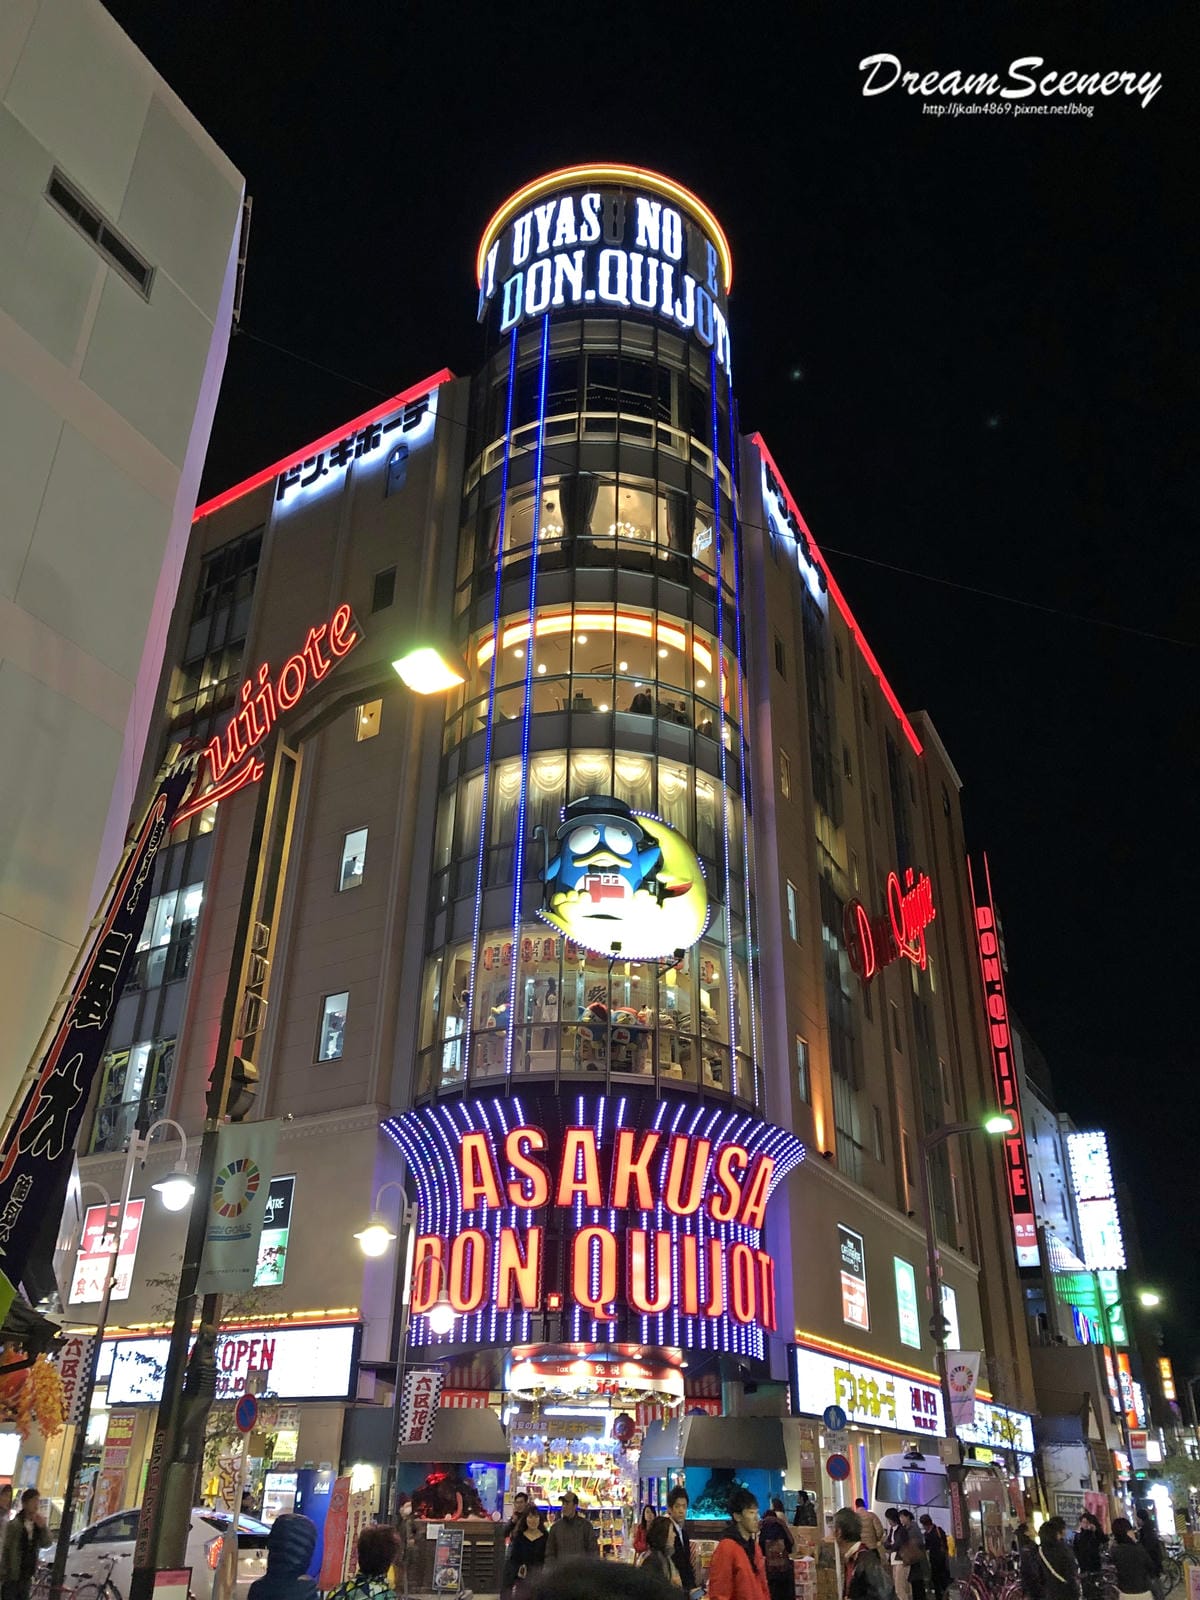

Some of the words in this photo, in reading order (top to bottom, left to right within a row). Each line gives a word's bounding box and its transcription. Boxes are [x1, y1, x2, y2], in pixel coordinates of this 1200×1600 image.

[635, 196, 683, 262] NO
[459, 1124, 776, 1230] ASAKUSA
[410, 1225, 779, 1333] DON.QUIJOT
[221, 1339, 276, 1371] OPEN
[407, 1376, 433, 1443] 六区花道
